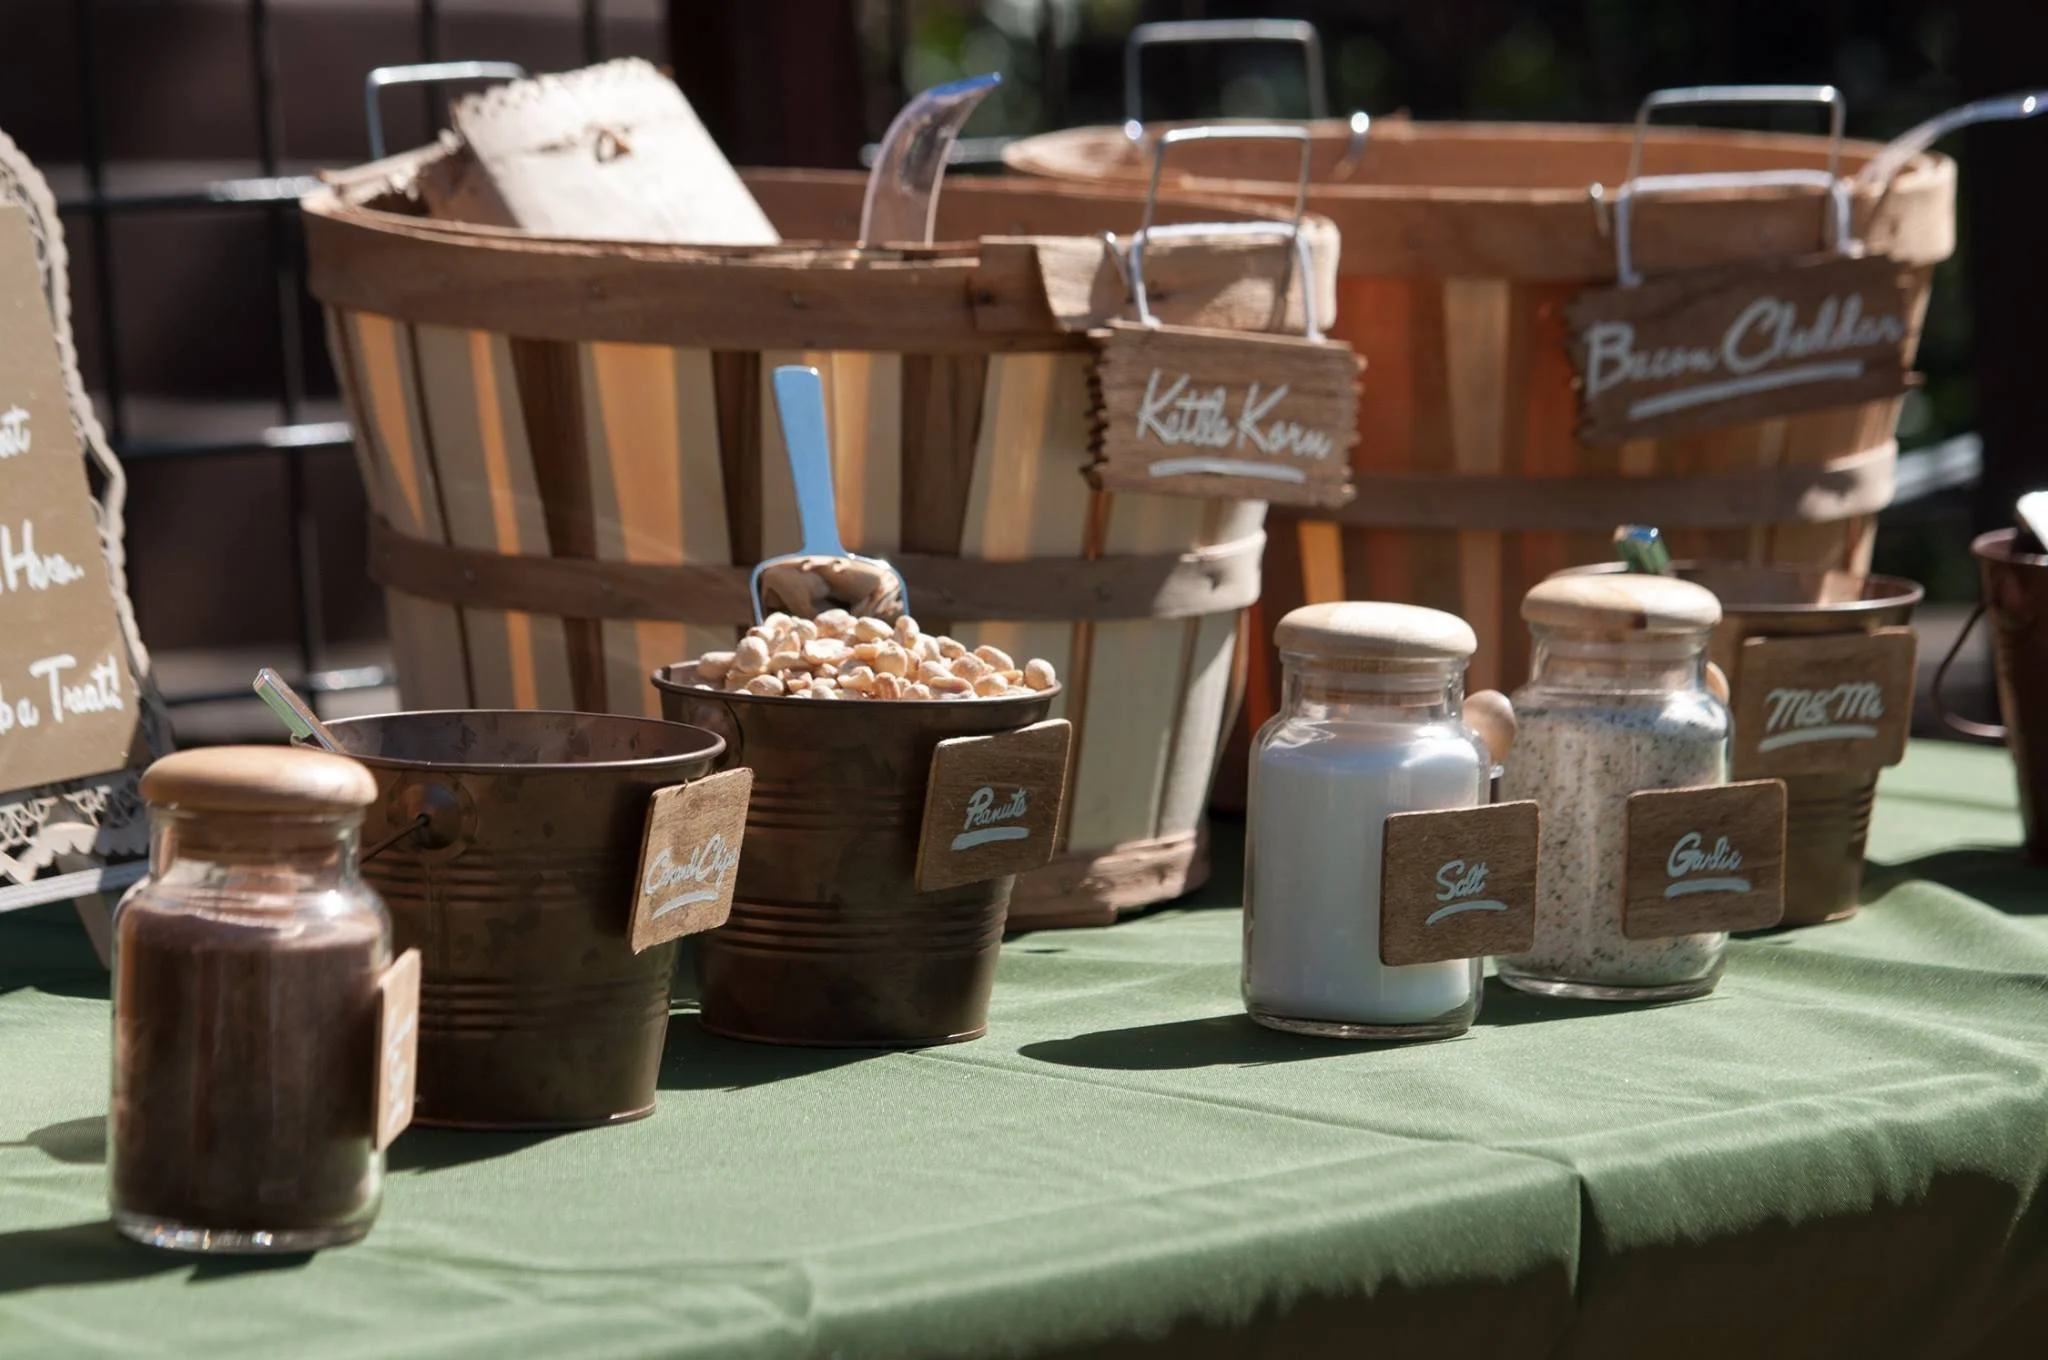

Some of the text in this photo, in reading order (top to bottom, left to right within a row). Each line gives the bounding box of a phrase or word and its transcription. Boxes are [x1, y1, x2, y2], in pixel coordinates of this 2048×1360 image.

[1584, 295, 1905, 402] Bacon Cheddar
[1136, 368, 1334, 460] Kettle Korn
[963, 786, 1028, 831] Peanuts
[1667, 831, 1743, 877] Garlic
[1436, 859, 1490, 901] Salt
